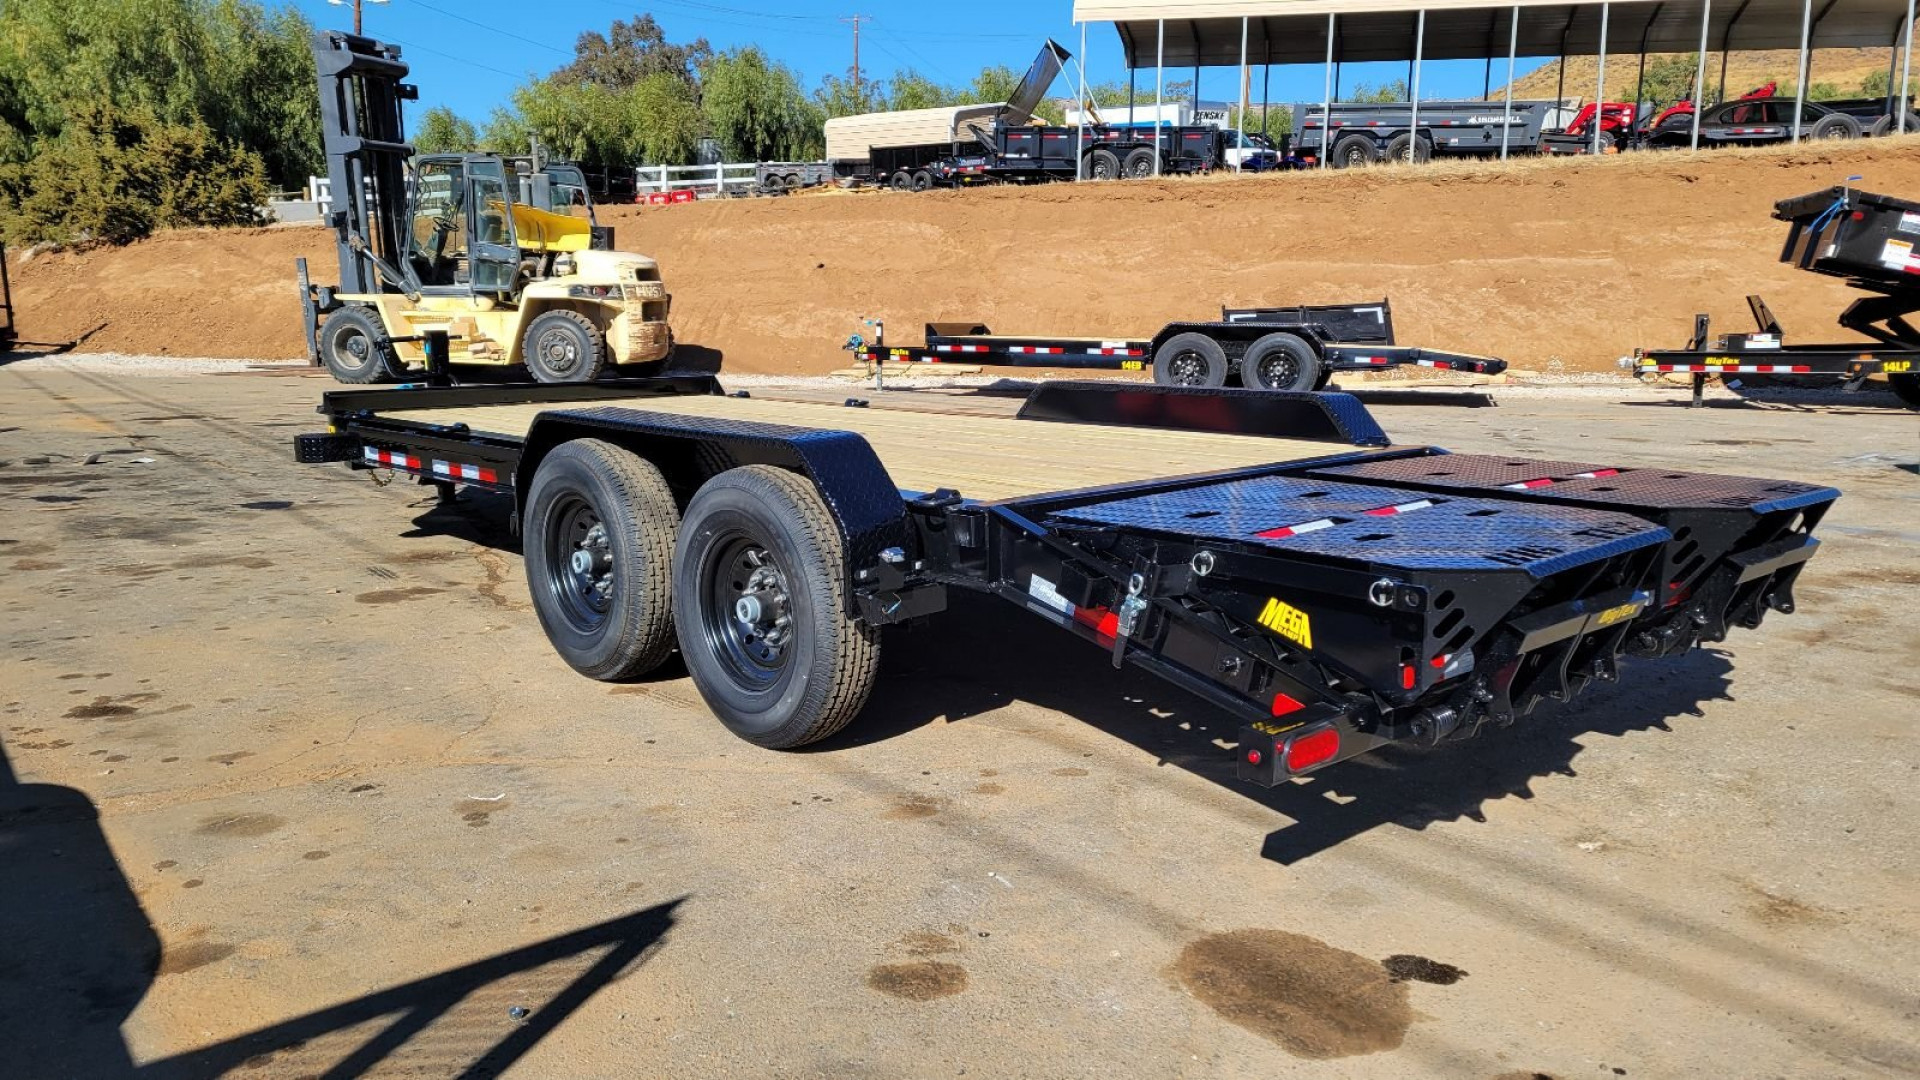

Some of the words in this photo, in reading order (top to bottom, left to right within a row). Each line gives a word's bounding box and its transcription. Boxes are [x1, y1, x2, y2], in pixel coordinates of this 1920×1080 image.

[1705, 356, 1740, 365] BigTex
[1883, 360, 1911, 372] 14LP
[1598, 604, 1637, 623] BigTex
[1257, 597, 1312, 649] MEGA
